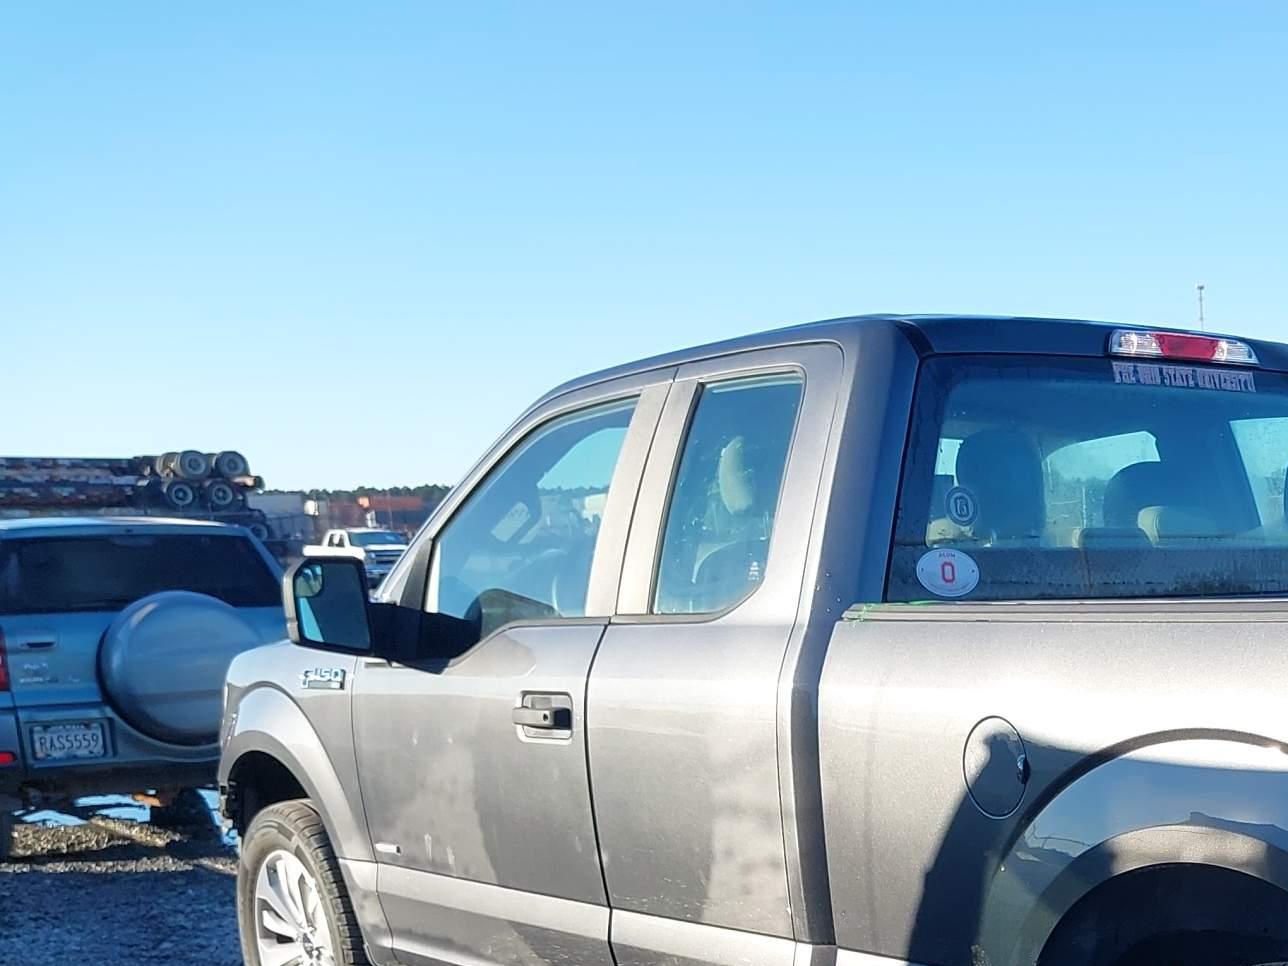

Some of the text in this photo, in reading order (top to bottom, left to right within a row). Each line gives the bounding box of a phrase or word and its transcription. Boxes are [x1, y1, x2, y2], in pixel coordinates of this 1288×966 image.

[1112, 362, 1136, 384] THE
[1162, 366, 1195, 388] STATE
[1196, 369, 1257, 393] UNIVERSITY
[39, 733, 99, 752] RAS5559
